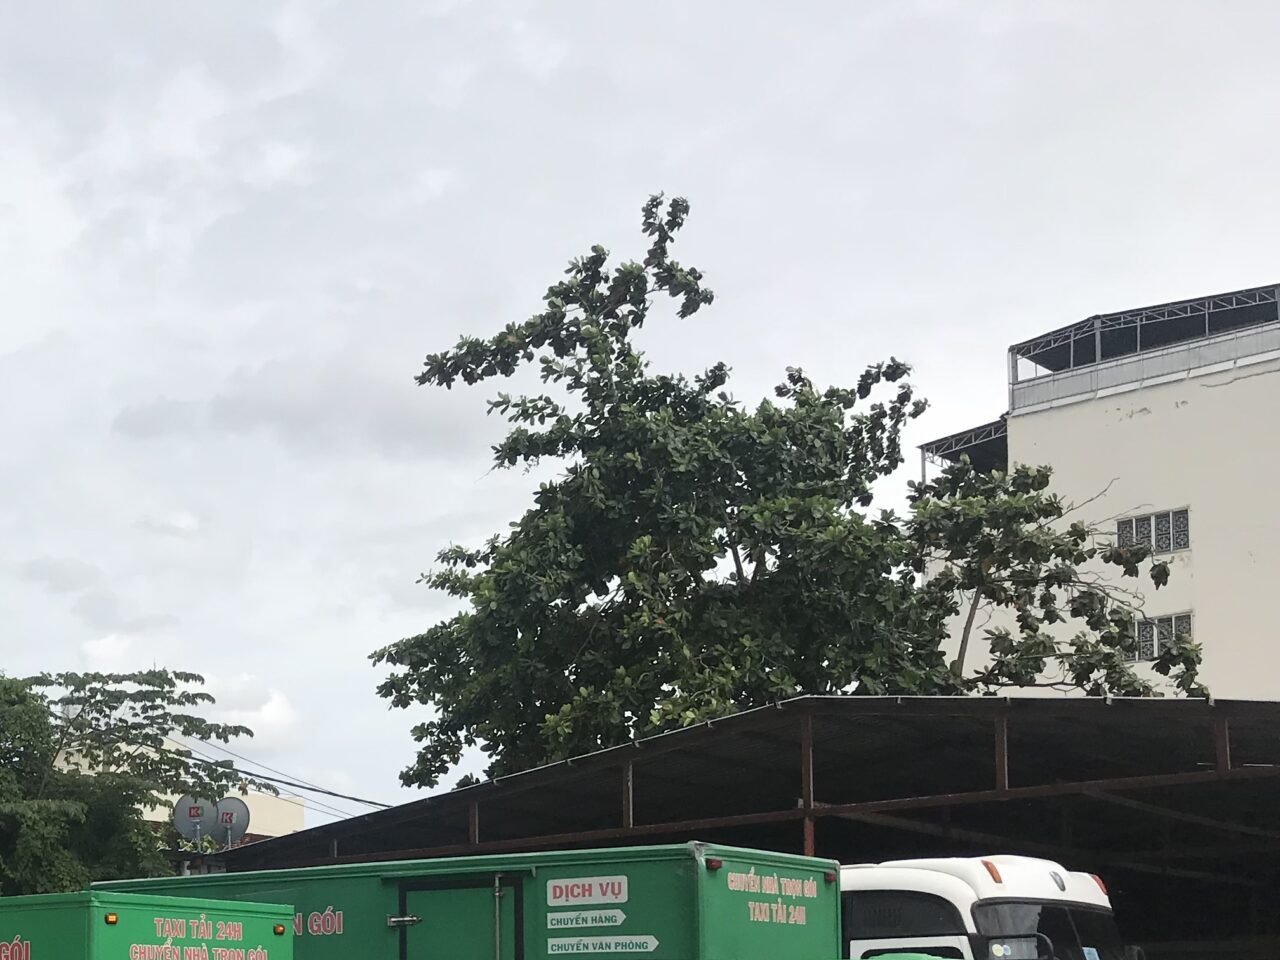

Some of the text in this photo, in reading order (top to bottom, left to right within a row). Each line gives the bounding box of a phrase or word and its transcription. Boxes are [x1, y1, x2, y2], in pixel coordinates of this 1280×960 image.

[552, 882, 622, 902] DỊCH VỤ
[308, 906, 343, 935] GÓI
[748, 902, 770, 922] TAXI
[154, 914, 242, 940] TAXI TẢI 24H
